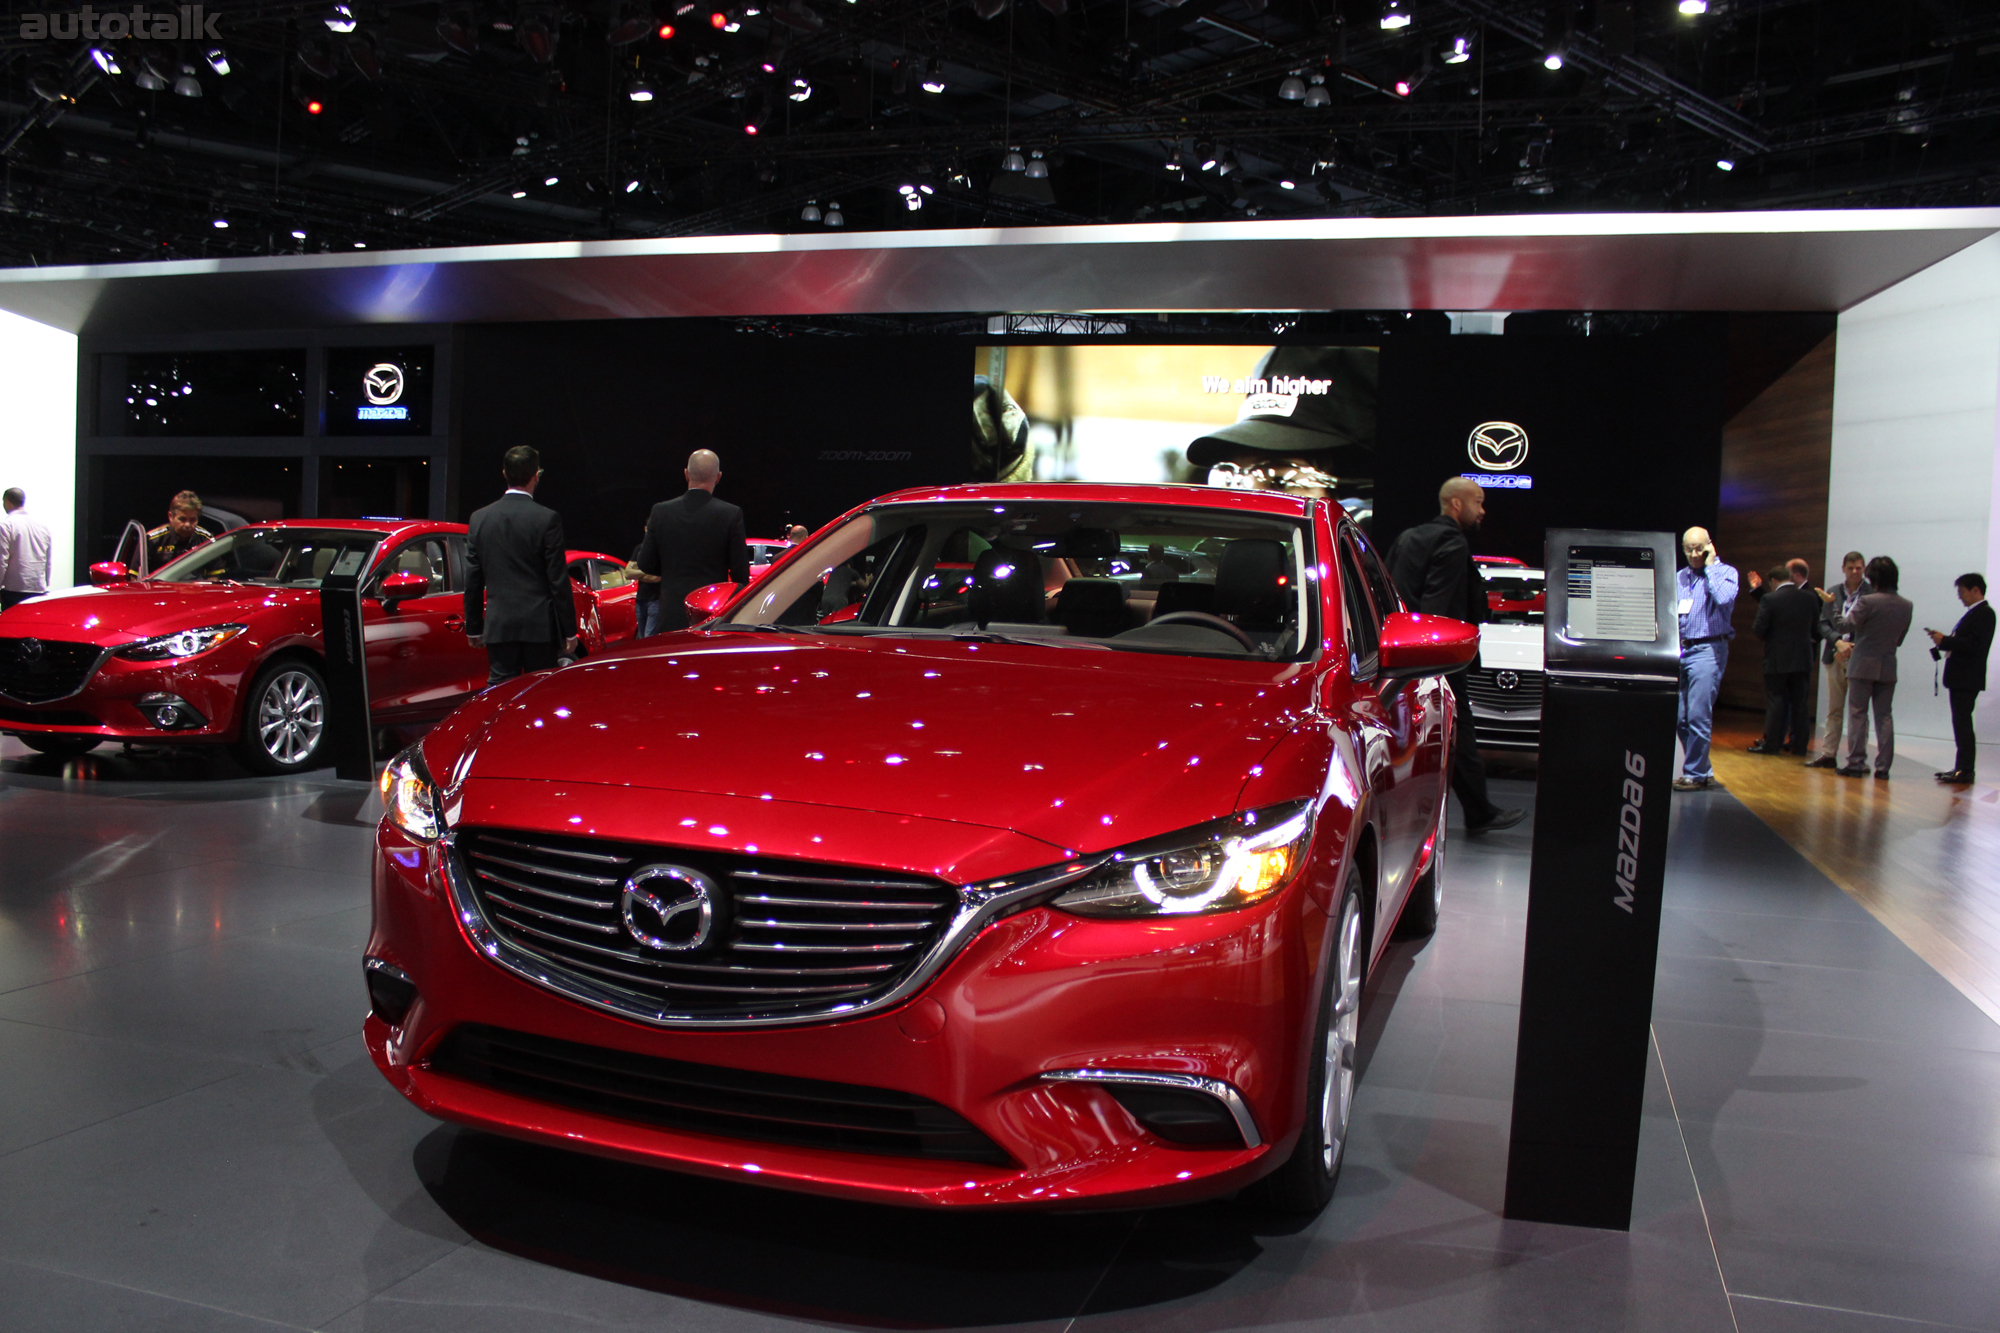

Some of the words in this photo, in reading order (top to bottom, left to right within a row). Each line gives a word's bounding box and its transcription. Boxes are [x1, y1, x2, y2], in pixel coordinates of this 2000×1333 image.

[1202, 375, 1229, 394] We
[1233, 375, 1267, 394] aim
[1271, 375, 1332, 398] higher
[817, 450, 912, 461] zoom-zoom
